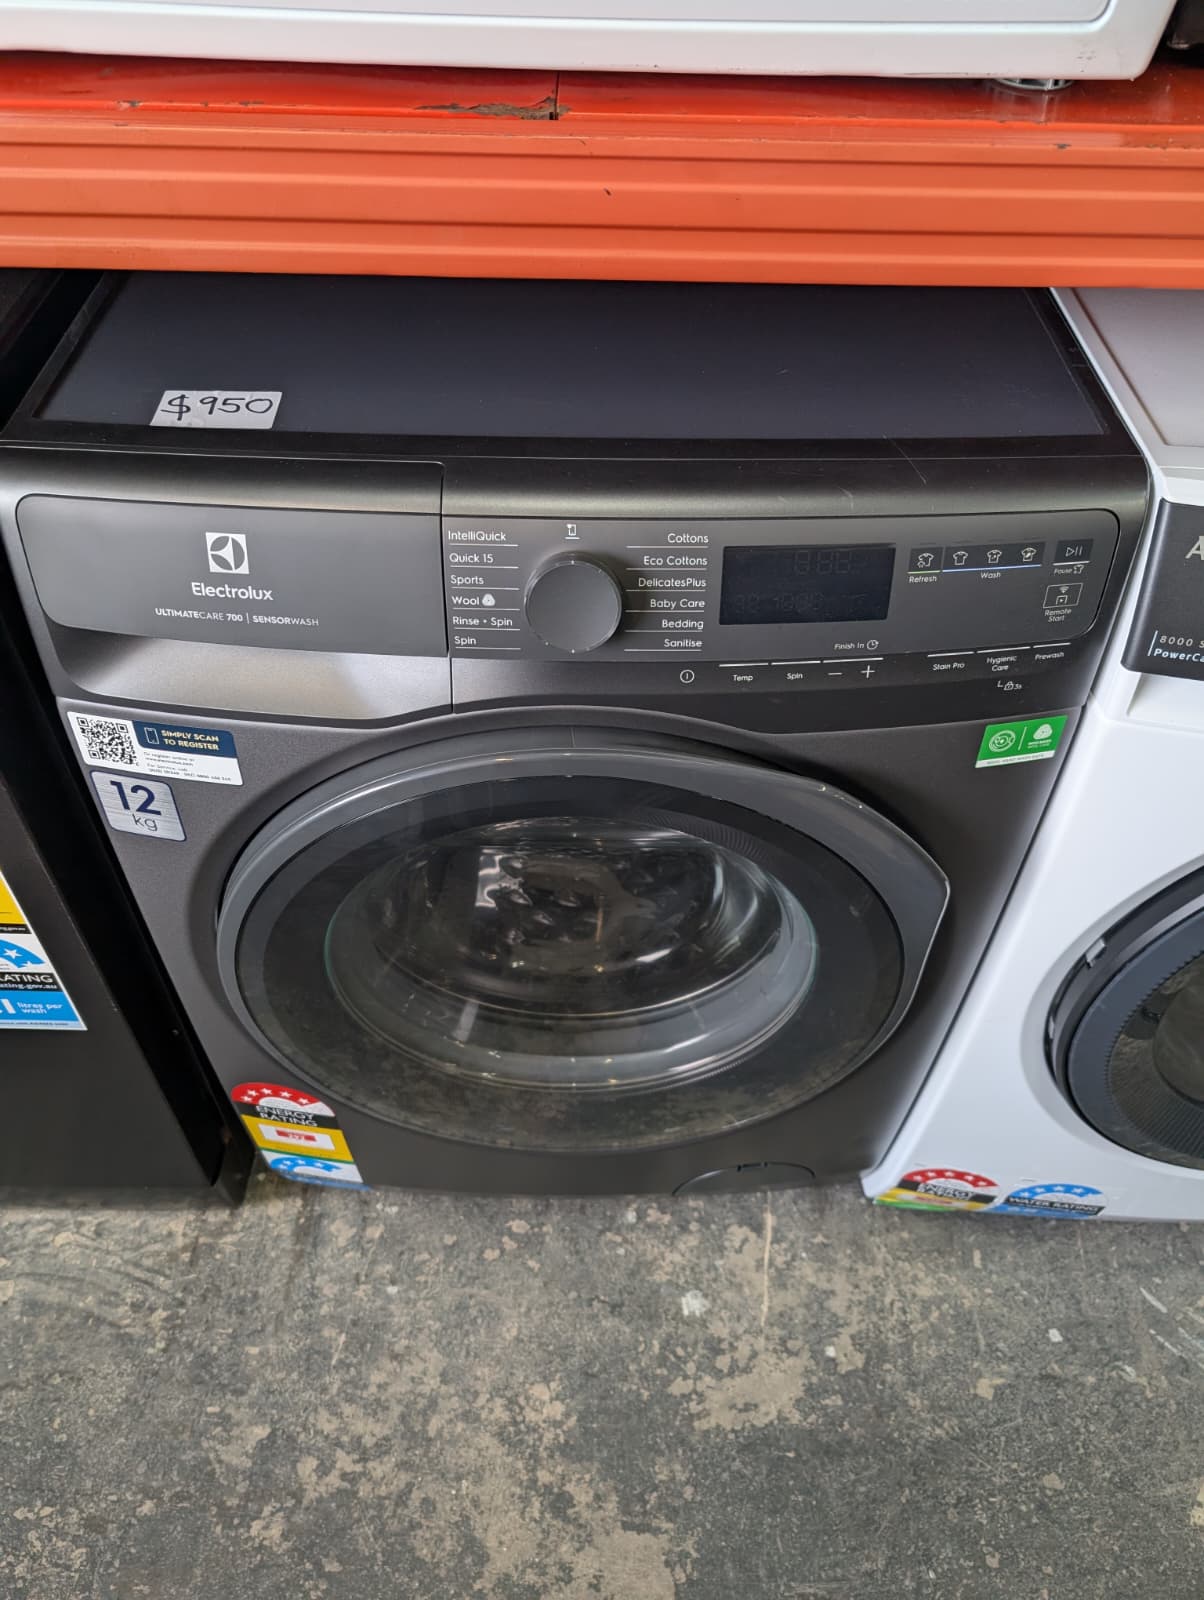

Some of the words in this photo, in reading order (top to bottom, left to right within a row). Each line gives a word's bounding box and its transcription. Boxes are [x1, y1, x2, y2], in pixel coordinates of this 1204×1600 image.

[448, 530, 506, 541] IntelliQuick
[667, 532, 709, 544] Cottons
[449, 553, 480, 564] Quick
[483, 553, 494, 564] 15
[643, 556, 663, 566] Eco
[666, 556, 708, 568] Cottons
[450, 575, 484, 586] Sports
[909, 575, 937, 583] Refresh
[980, 571, 1001, 579] Wash
[638, 578, 706, 588] DelicatesPlus
[191, 582, 274, 601] Electrolux
[451, 595, 480, 606] Wool
[650, 598, 676, 610] Baby
[679, 599, 706, 609] Care
[154, 606, 225, 621] ULTIMATECARE
[225, 612, 244, 622] 700
[252, 614, 320, 627] SENSORWASH
[1044, 608, 1072, 617] Remote
[452, 616, 480, 627] Rinse
[490, 617, 513, 628] Spin
[662, 619, 704, 630] Bedding
[1047, 615, 1066, 623] Start
[454, 636, 476, 646] Spin
[664, 638, 703, 648] Sanitise
[834, 642, 855, 650] Finish
[1160, 635, 1193, 646] 8000
[986, 655, 1017, 664] Hygienic
[932, 662, 951, 671] Stain
[952, 662, 966, 670] Pro
[991, 664, 1009, 672] Care
[732, 674, 754, 683] Temp
[786, 672, 804, 681] Spin
[161, 730, 192, 740] SIMPLY
[193, 733, 220, 742] SCAN
[163, 738, 176, 746] TO
[178, 740, 220, 750] REGISTER
[110, 780, 161, 815] 12
[132, 813, 158, 832] kg
[256, 1105, 314, 1120] ENERGY
